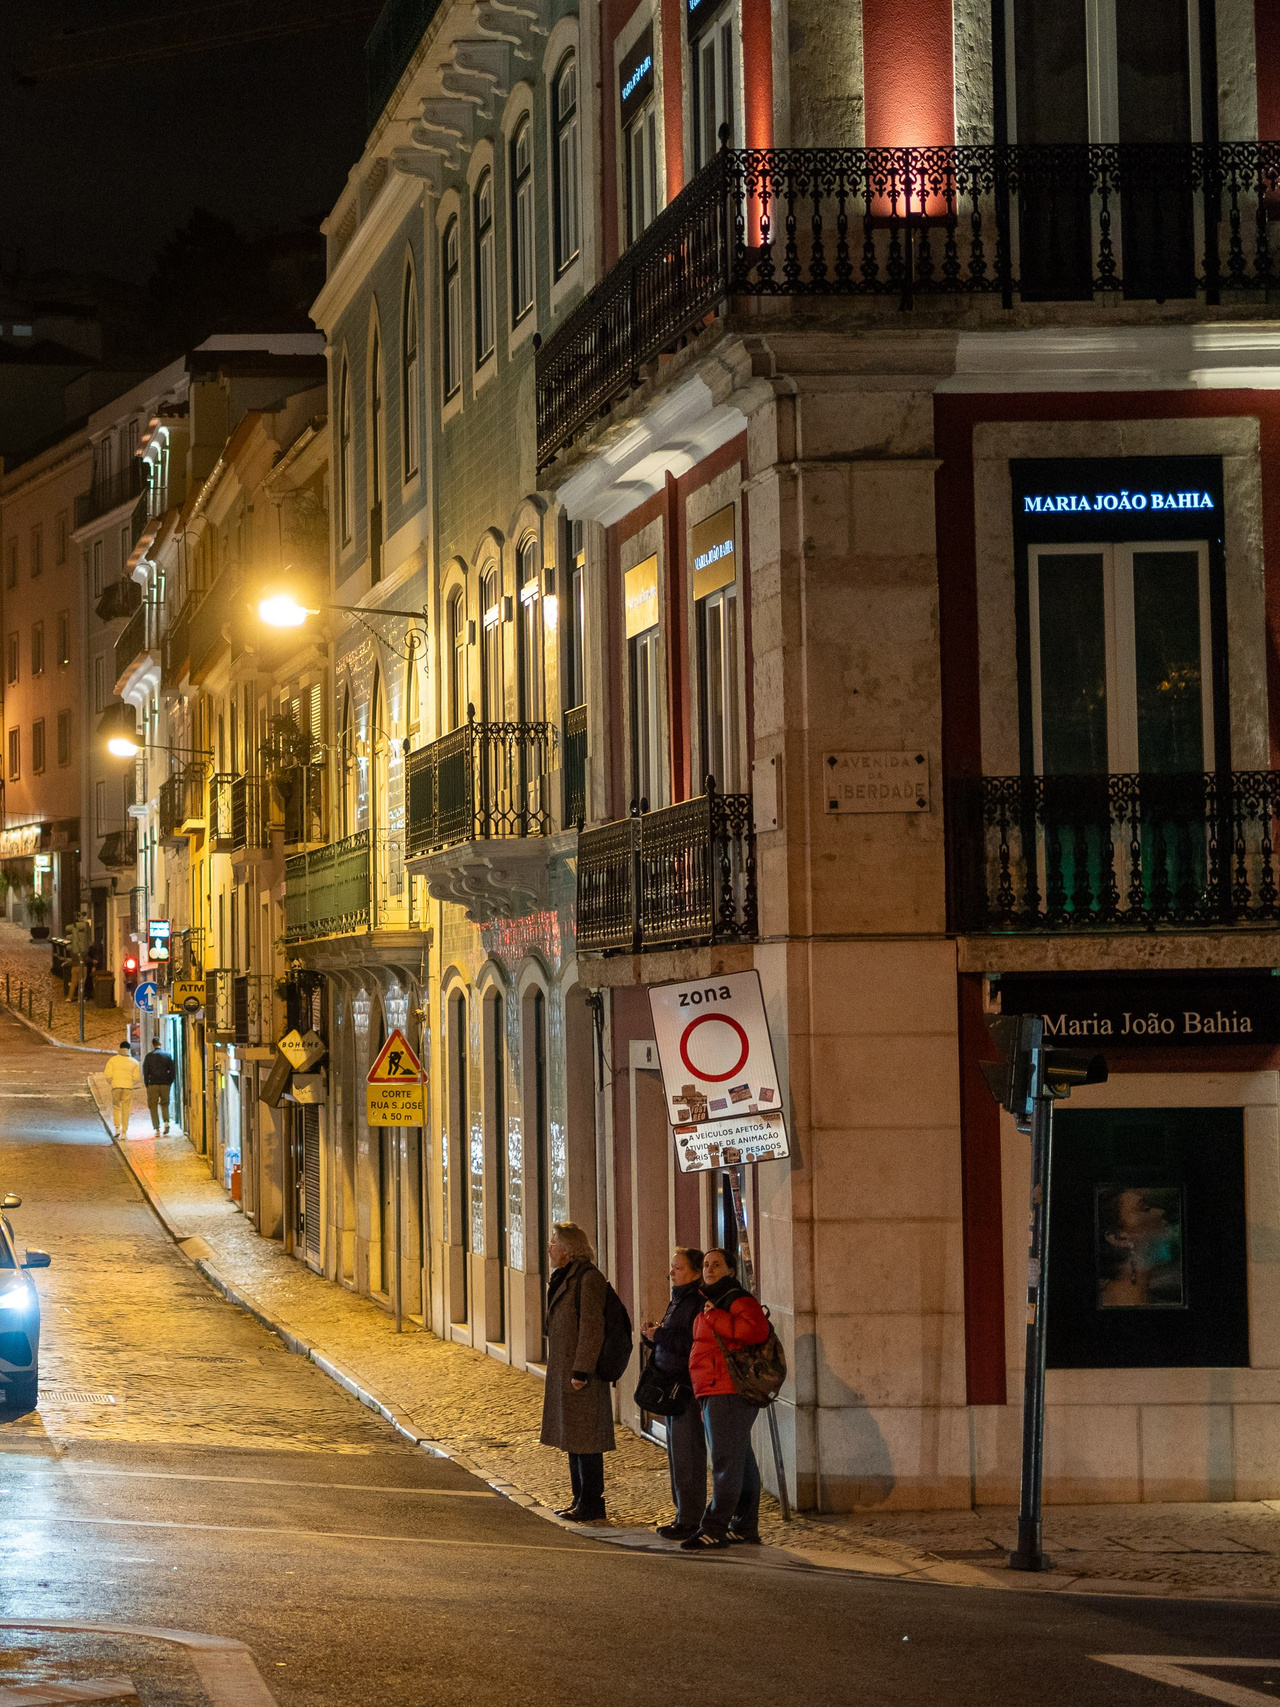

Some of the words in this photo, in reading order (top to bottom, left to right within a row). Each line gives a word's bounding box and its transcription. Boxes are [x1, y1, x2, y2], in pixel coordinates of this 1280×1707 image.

[1024, 496, 1091, 512] MARIA
[1093, 491, 1148, 511] JOÃO
[1150, 492, 1214, 509] BAHIA
[840, 756, 910, 768] AVENIDA
[868, 772, 883, 780] DA
[827, 782, 926, 800] LIBERDADE
[180, 984, 205, 992] ATM
[678, 985, 732, 1007] zona
[1042, 1012, 1113, 1036] Maria
[1120, 1012, 1175, 1035] João
[1183, 1010, 1253, 1035] Bahia
[381, 1090, 412, 1098] CORTE
[370, 1101, 390, 1109] RUA
[391, 1101, 400, 1109] S.
[400, 1100, 423, 1110] JOSÉ
[381, 1112, 388, 1120] A
[390, 1112, 402, 1120] 50
[696, 1128, 733, 1140] VEÍCULOS
[735, 1123, 764, 1133] AFETOS
[725, 1138, 736, 1146] DE
[738, 1131, 779, 1144] ANIMAÇÃO
[746, 1142, 782, 1153] PESADOS
